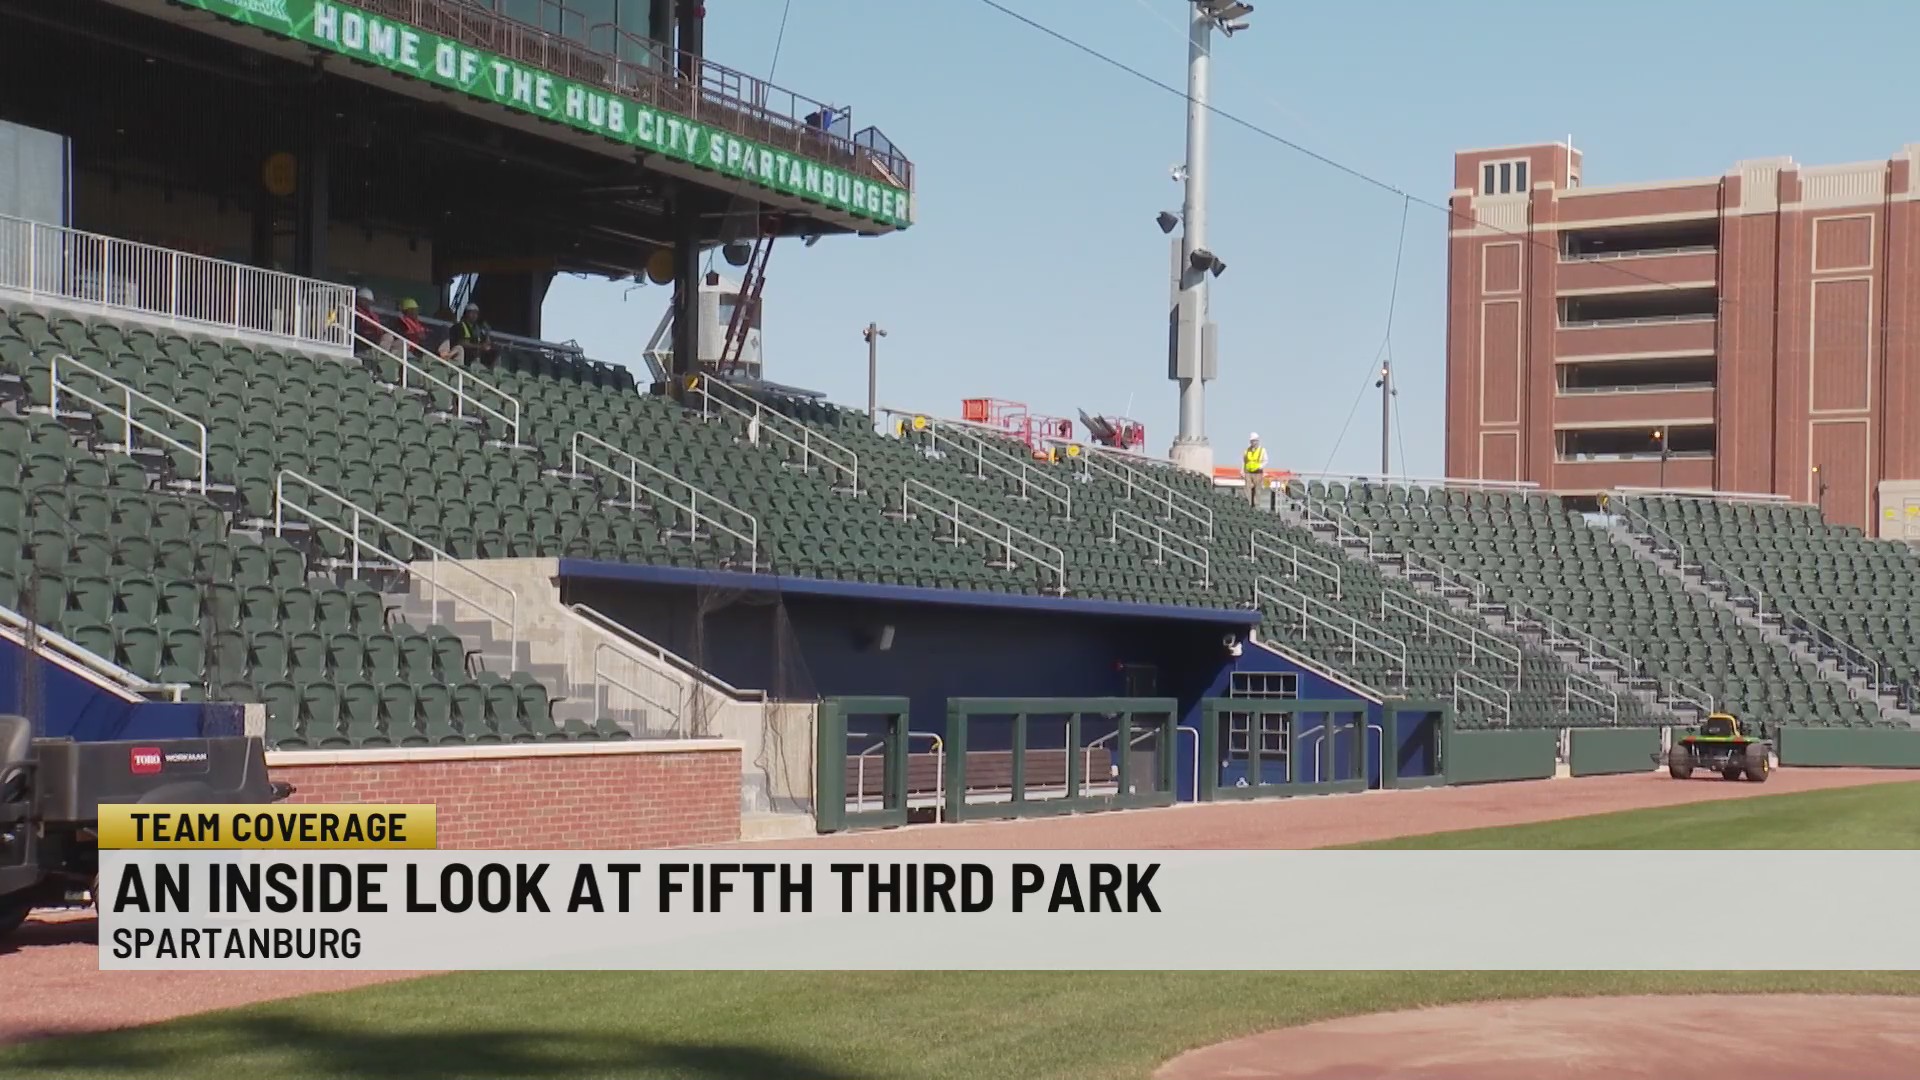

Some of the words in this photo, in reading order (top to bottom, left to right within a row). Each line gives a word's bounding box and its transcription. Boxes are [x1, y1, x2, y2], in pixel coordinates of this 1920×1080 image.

[314, 2, 420, 69] HOME
[436, 43, 480, 84] OF
[491, 61, 554, 111] THE
[566, 86, 625, 133] HUB
[638, 109, 699, 156] CITY
[710, 133, 908, 221] SPARTANBURGER
[134, 754, 161, 765] TORO
